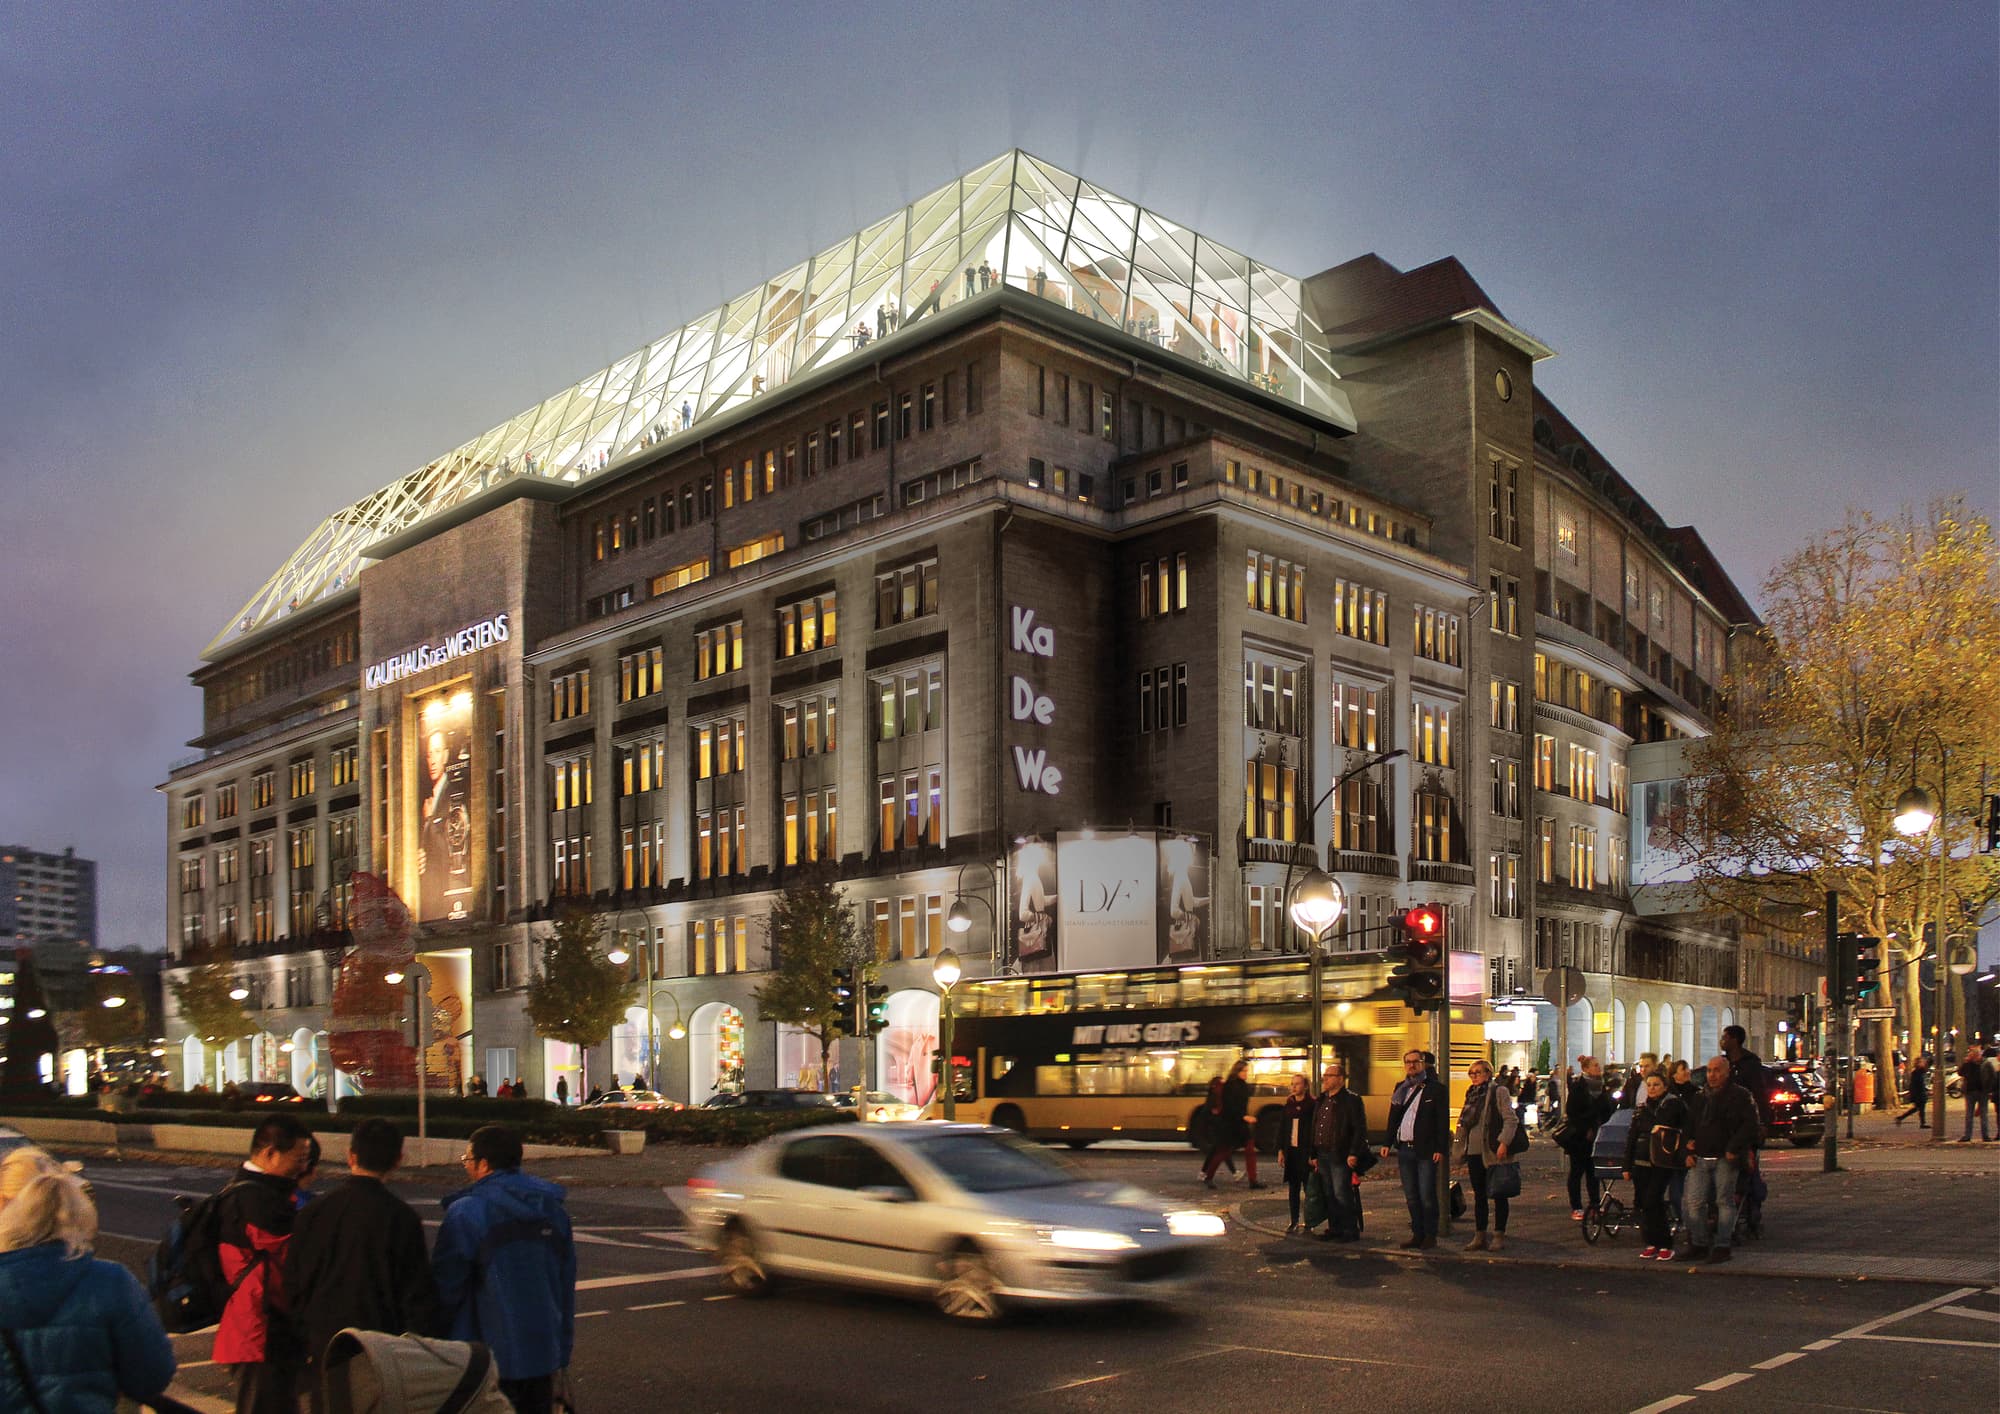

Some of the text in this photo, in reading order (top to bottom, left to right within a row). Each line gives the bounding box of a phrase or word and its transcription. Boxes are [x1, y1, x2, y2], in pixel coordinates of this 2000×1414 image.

[365, 614, 510, 690] KAUFHAUS DES WESTENS
[1010, 605, 1055, 657] Ka
[1010, 675, 1056, 725] De
[1012, 745, 1063, 795] We
